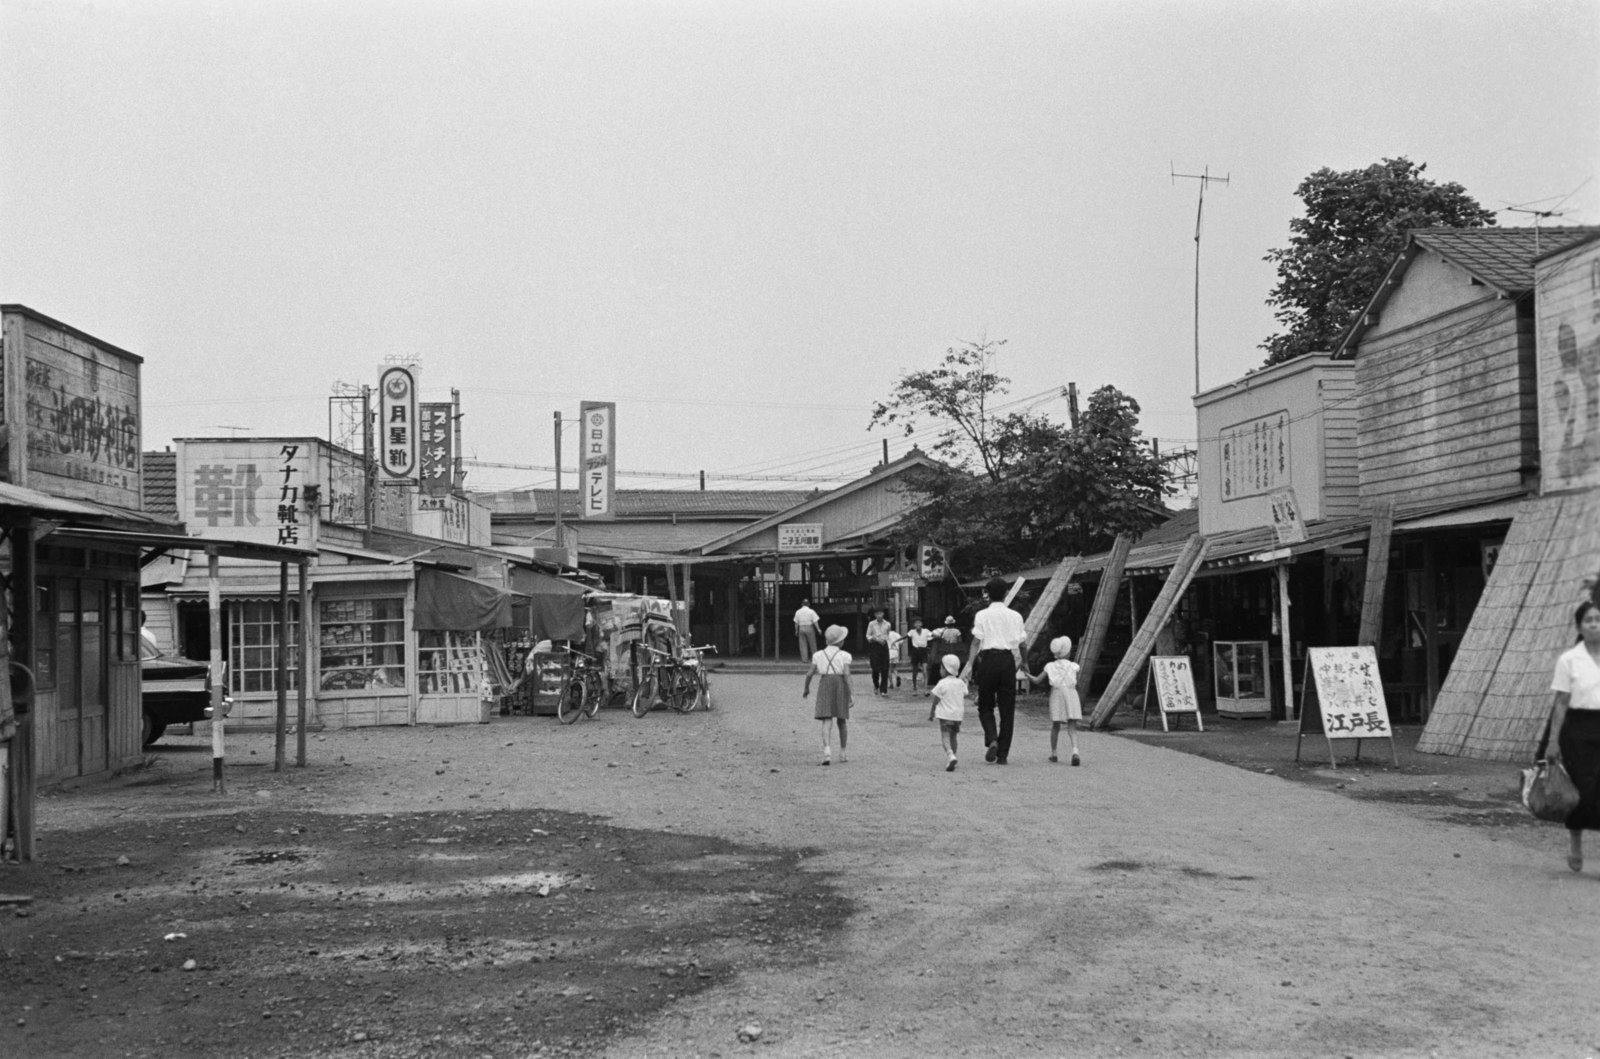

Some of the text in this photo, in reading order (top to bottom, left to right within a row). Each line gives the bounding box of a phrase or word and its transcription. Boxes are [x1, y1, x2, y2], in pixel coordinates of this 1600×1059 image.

[389, 405, 407, 466] 月星靴
[433, 411, 446, 478] プラチナ
[194, 463, 264, 527] 靴
[277, 445, 300, 546] タナカ靴店
[591, 472, 603, 510] テレビ
[1326, 711, 1388, 733] 江戸長
